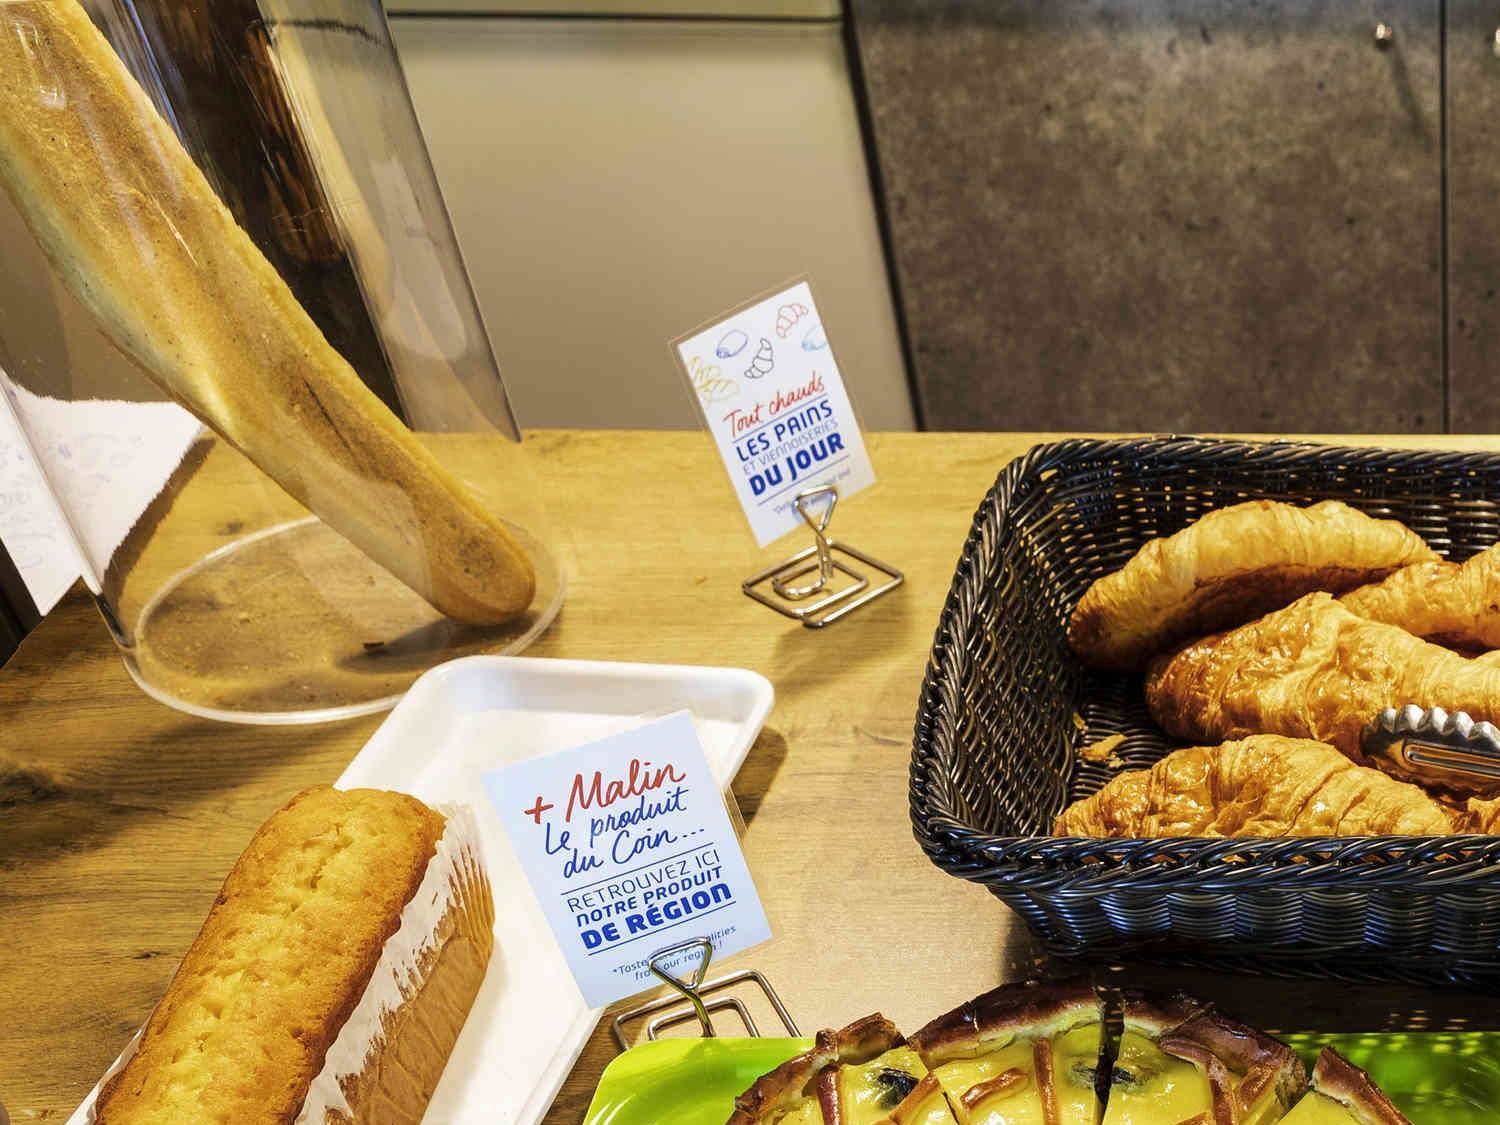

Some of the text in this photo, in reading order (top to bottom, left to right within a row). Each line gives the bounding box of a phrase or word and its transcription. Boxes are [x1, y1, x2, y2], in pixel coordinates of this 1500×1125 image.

[723, 372, 825, 438] Tout chauds
[736, 400, 833, 462] LES PAINS
[743, 419, 839, 476] ET VIENNOISERIES
[749, 465, 783, 496] DU
[788, 432, 845, 481] JOUR
[565, 759, 687, 822] Malin
[589, 786, 689, 848] produit
[563, 848, 603, 878] du
[567, 849, 720, 913] RETROUVEZ ICI
[575, 866, 722, 927] NOTRE PRODUIT
[580, 882, 732, 950] DE RÉGION
